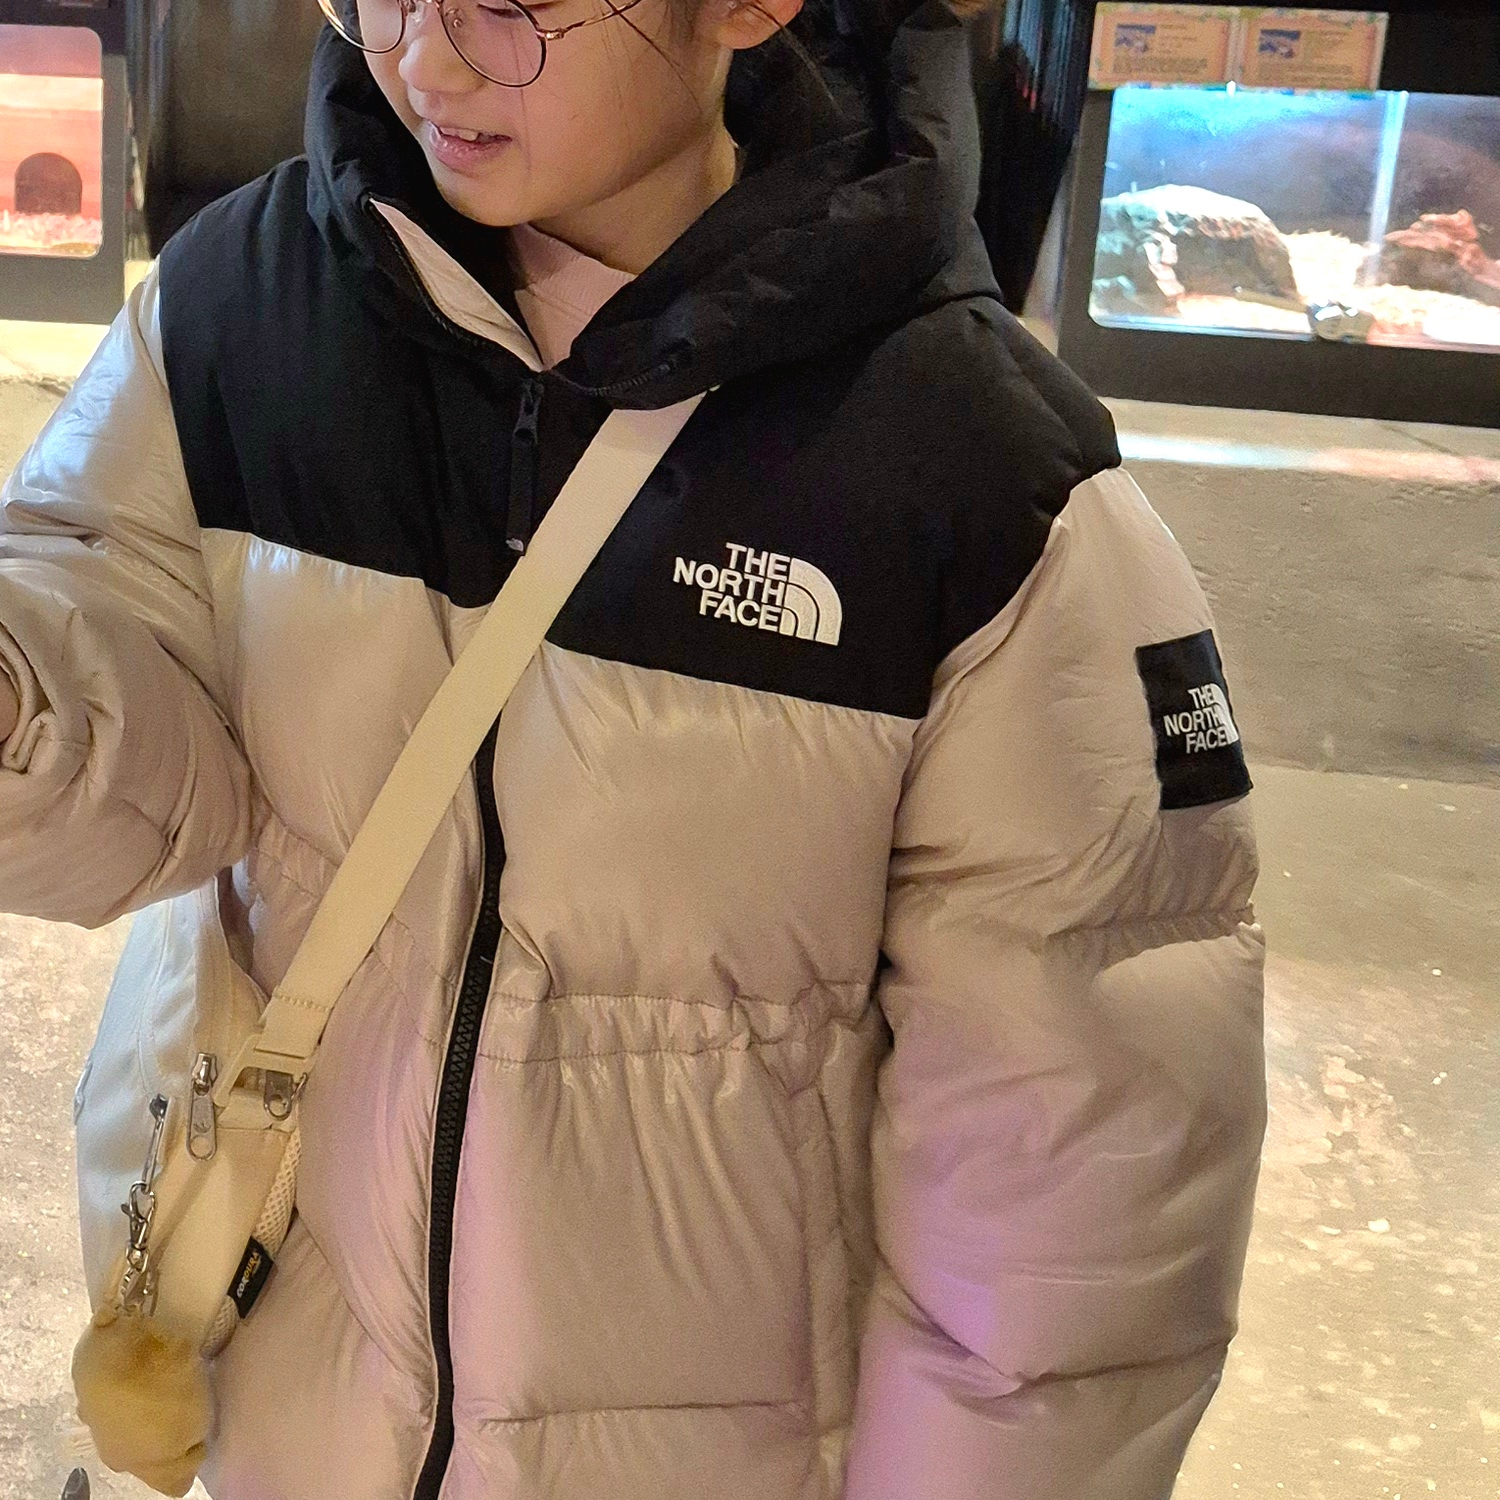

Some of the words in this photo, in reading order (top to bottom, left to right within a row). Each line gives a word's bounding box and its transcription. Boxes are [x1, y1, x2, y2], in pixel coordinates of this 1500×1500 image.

[726, 542, 791, 582] THE
[673, 557, 786, 606] NORTH
[699, 589, 782, 633] FACE
[1187, 684, 1215, 709] THE
[1163, 706, 1223, 736] NORTH
[1185, 726, 1227, 754] FACE
